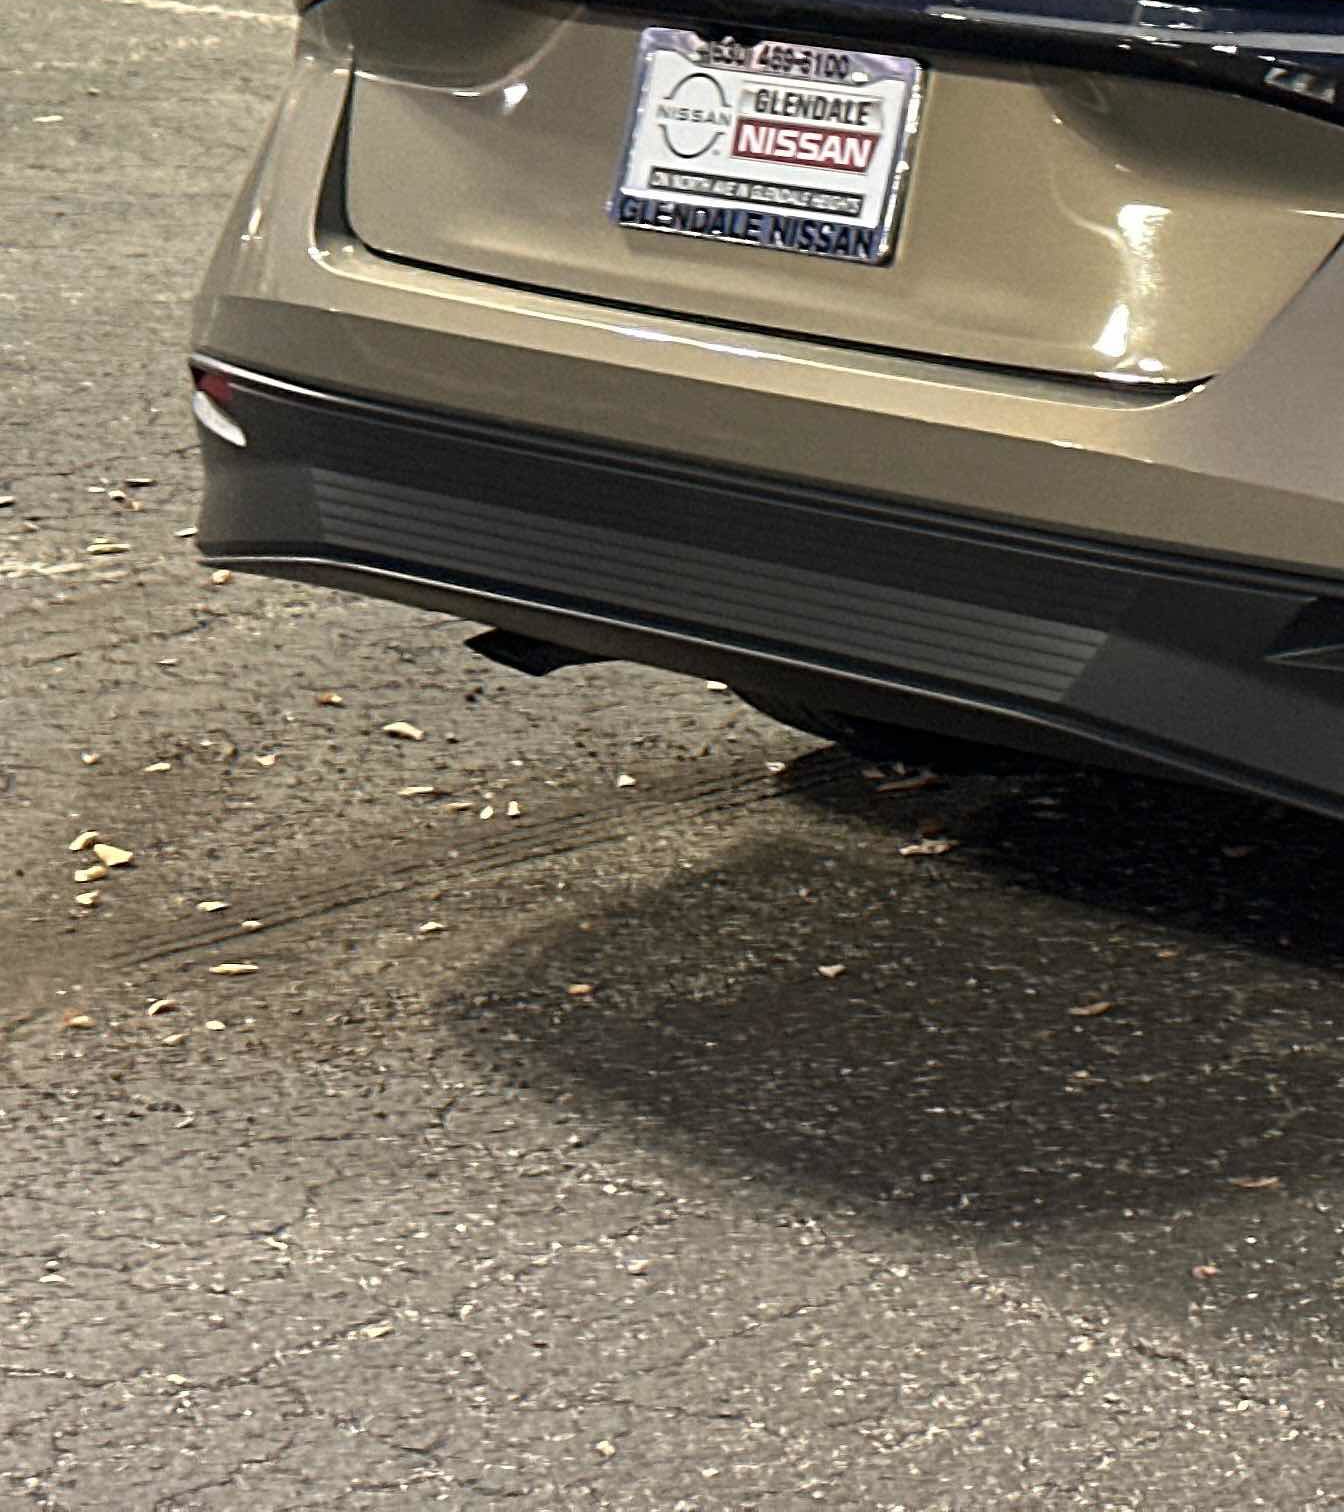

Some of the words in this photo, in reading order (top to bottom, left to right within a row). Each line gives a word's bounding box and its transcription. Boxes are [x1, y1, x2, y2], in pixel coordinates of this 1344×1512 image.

[656, 103, 731, 126] NISSAN
[754, 88, 873, 125] GLENDALE
[737, 124, 873, 168] NISSAN
[619, 197, 761, 241] GLENDALE
[770, 215, 874, 258] NISSAN
